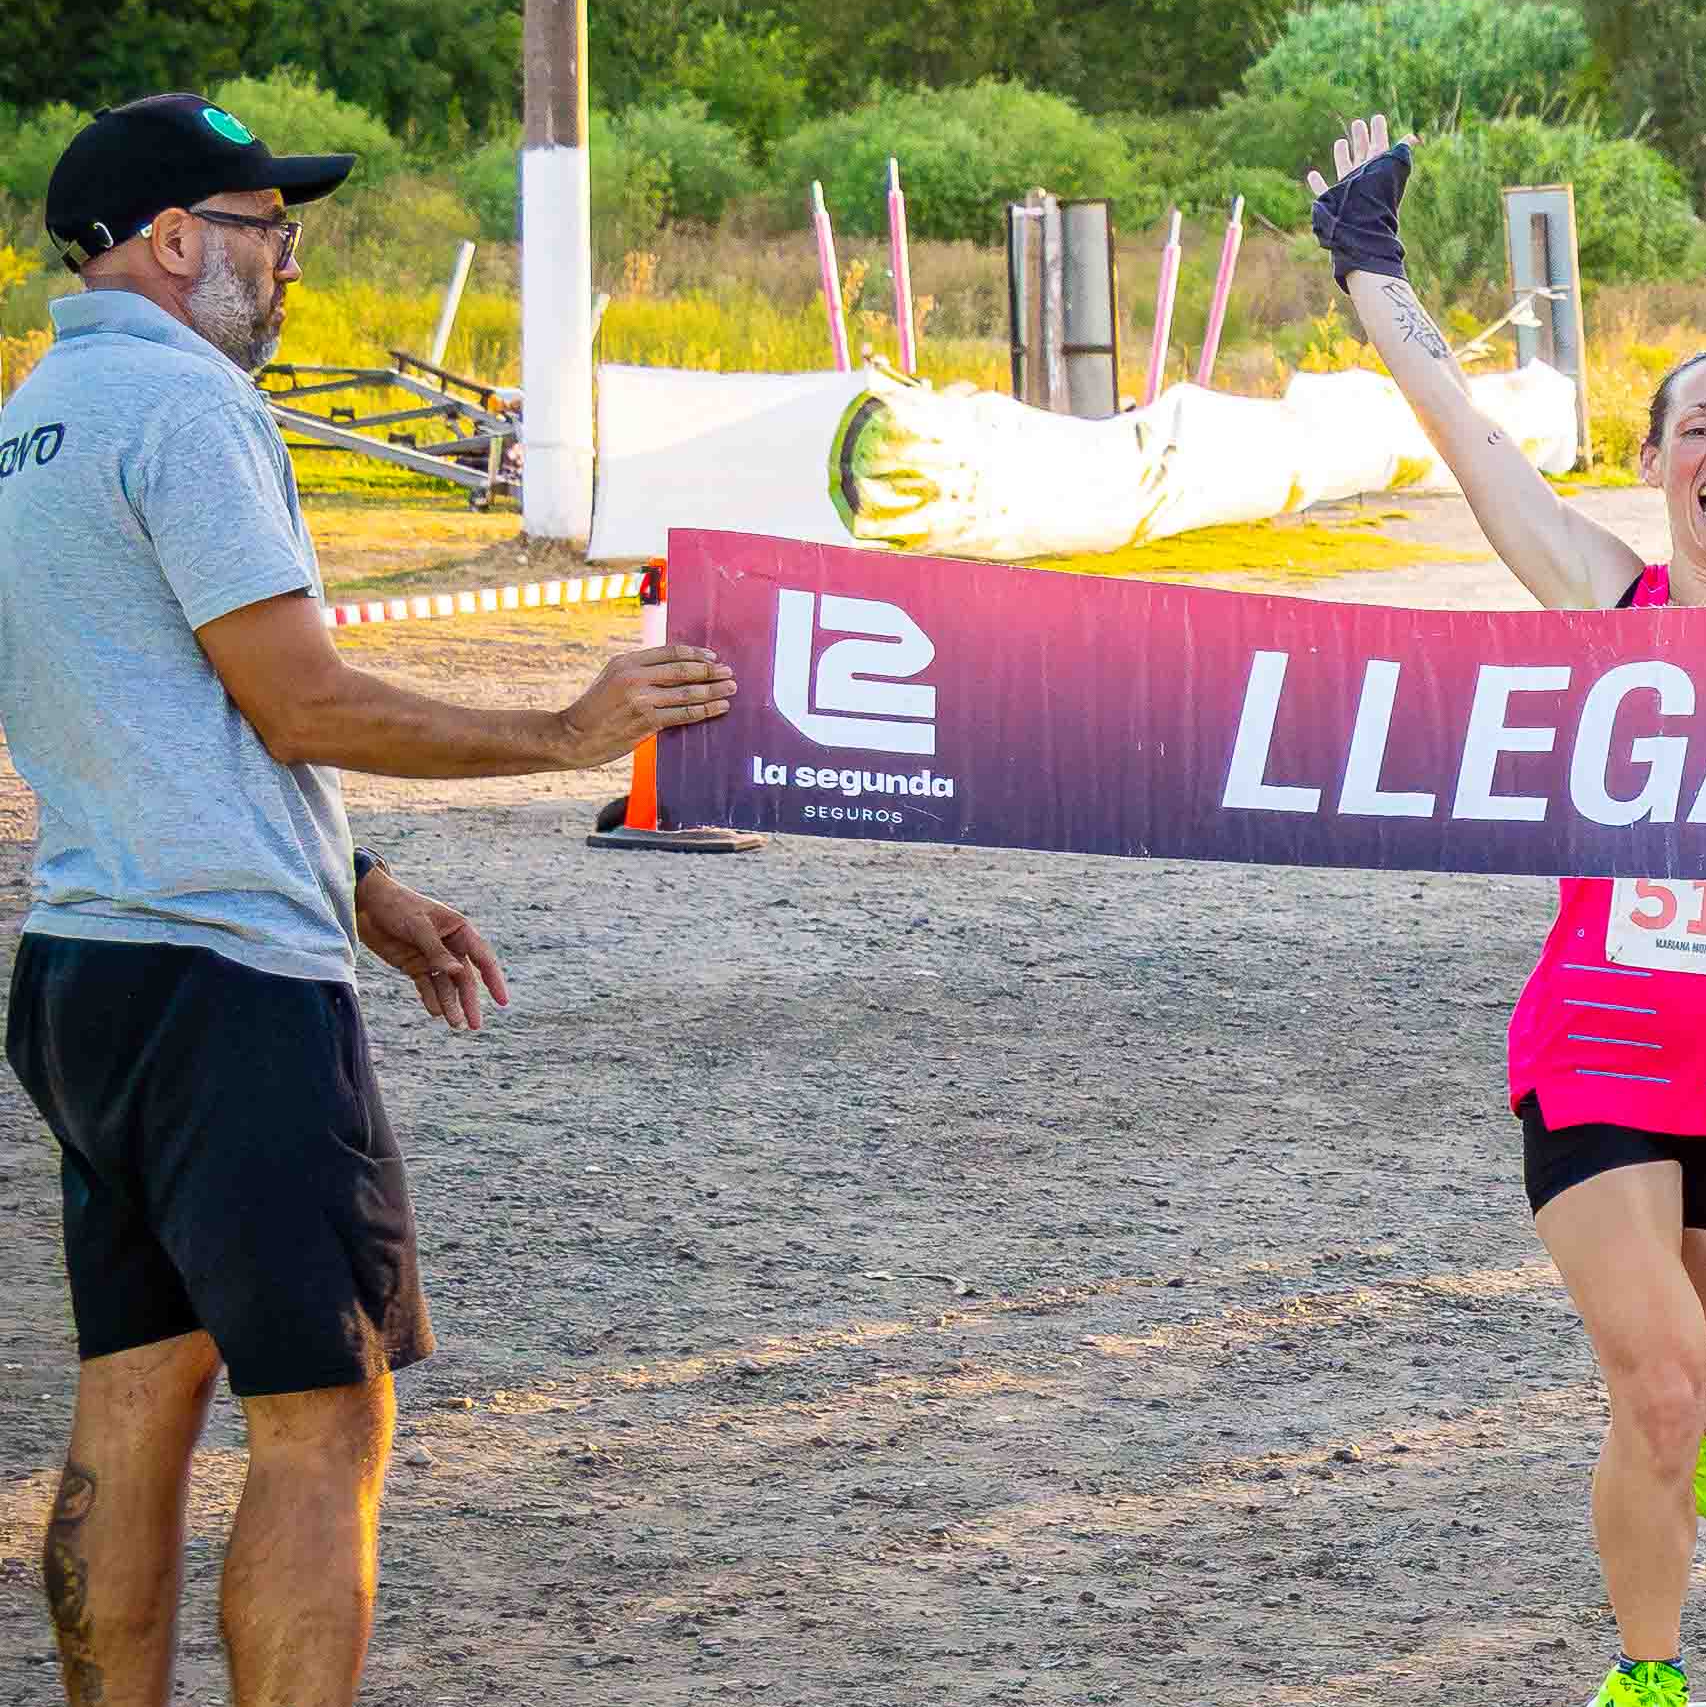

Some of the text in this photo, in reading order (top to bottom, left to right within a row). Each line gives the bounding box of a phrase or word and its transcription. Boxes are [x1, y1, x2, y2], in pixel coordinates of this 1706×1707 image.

[752, 755, 955, 798] la segunda
[803, 805, 904, 824] SEGUROS
